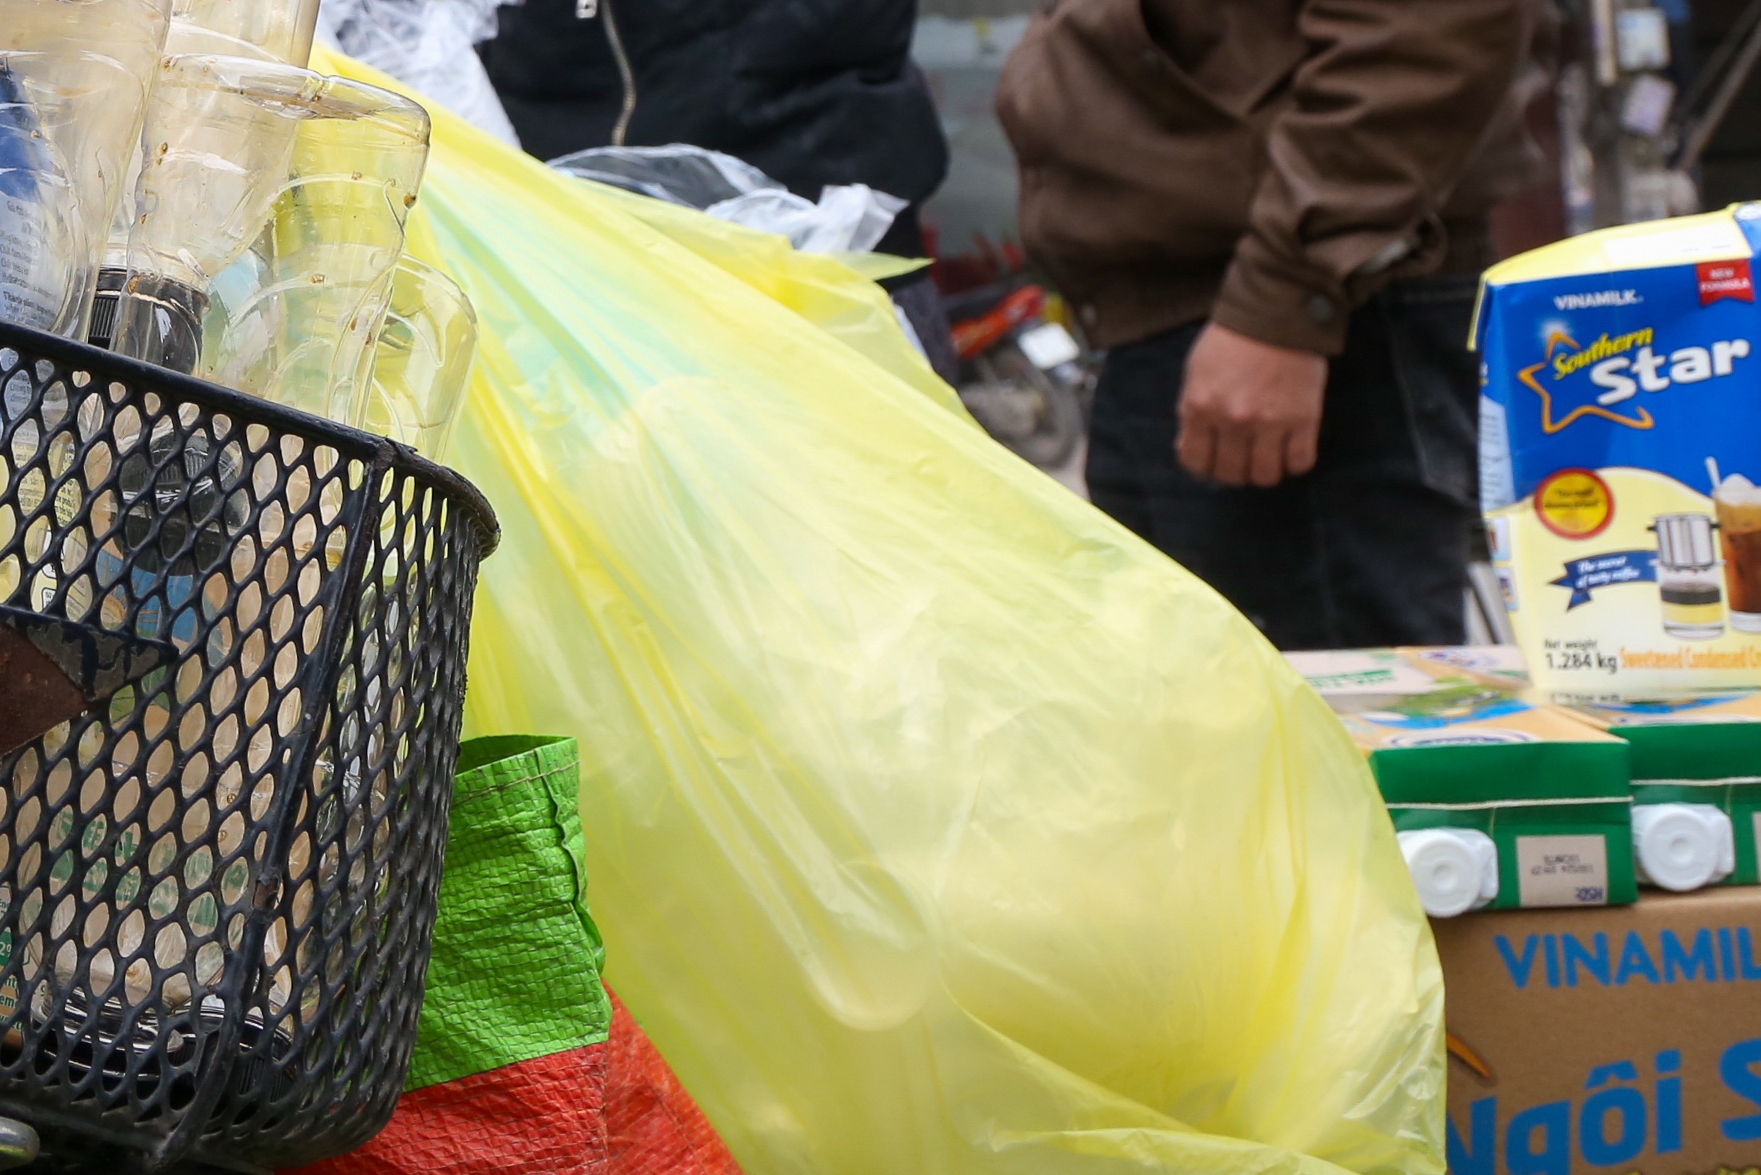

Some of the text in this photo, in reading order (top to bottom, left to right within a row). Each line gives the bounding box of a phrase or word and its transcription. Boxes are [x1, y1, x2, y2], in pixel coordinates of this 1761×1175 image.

[1553, 289, 1638, 311] VINAMILK
[1552, 326, 1654, 380] Southern
[1589, 337, 1750, 406] Star
[1546, 652, 1618, 674] 1.284 kg
